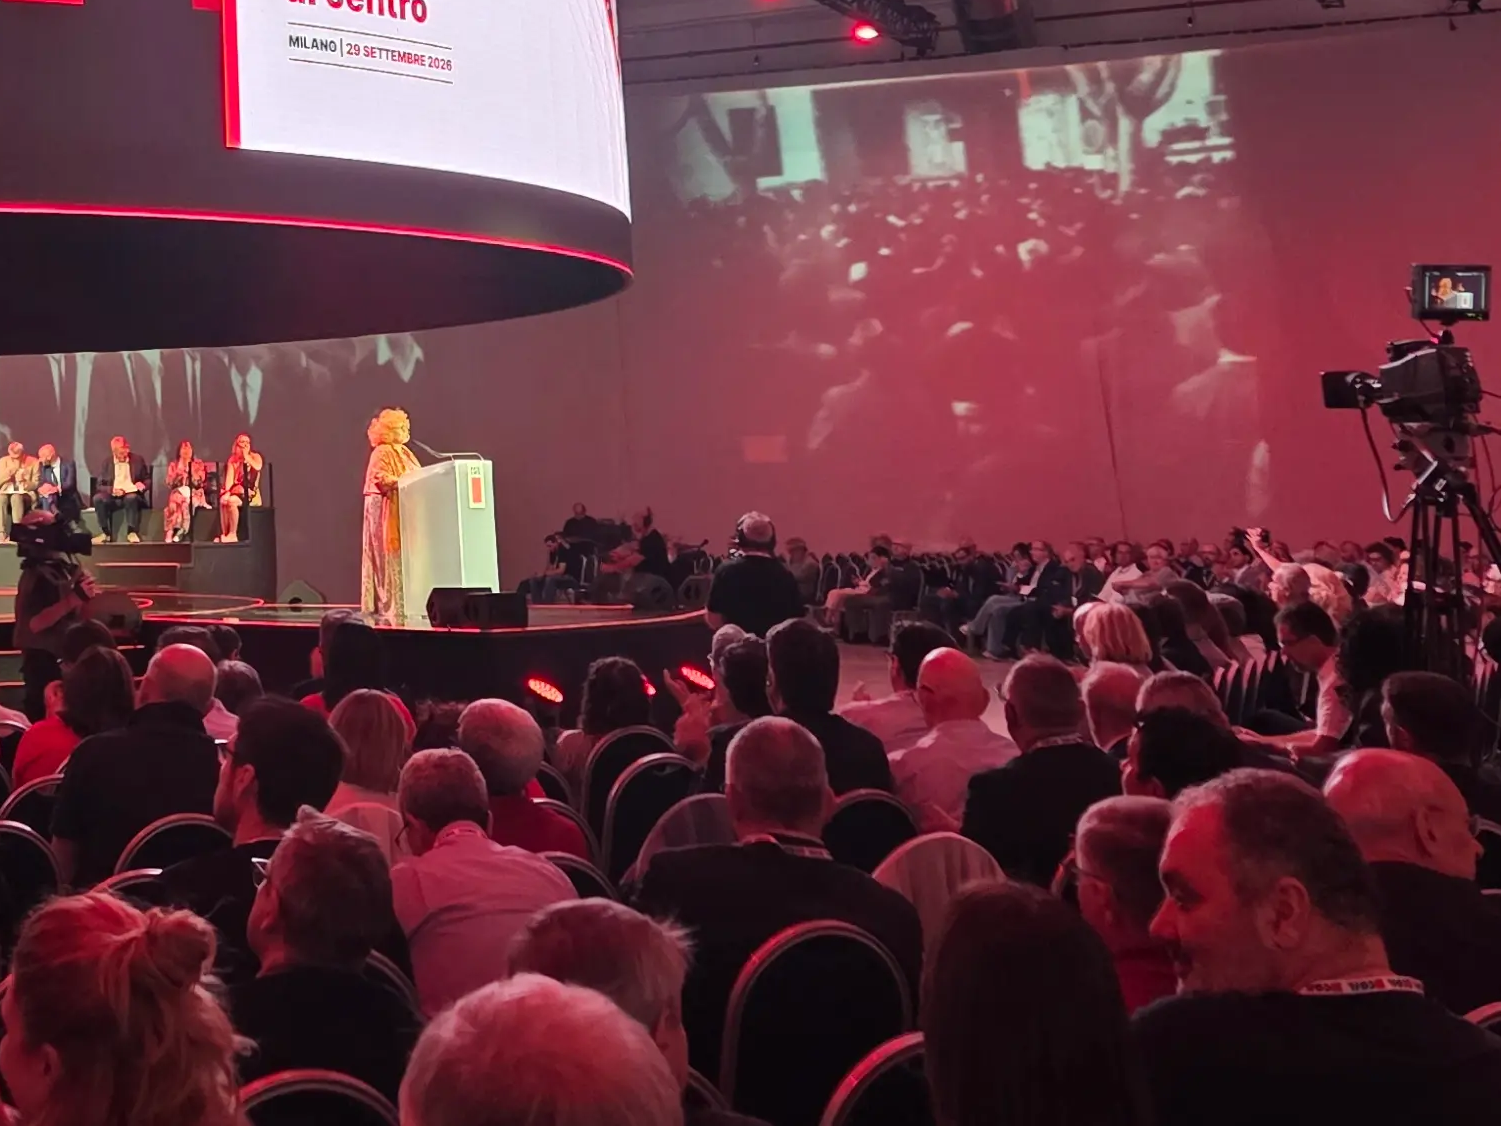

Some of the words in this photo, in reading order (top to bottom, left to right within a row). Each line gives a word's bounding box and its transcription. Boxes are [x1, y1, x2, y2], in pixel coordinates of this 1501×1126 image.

[288, 34, 337, 53] MILANO
[346, 42, 361, 57] 29
[363, 45, 426, 67] SETTEMBRE
[428, 56, 452, 72] 2026
